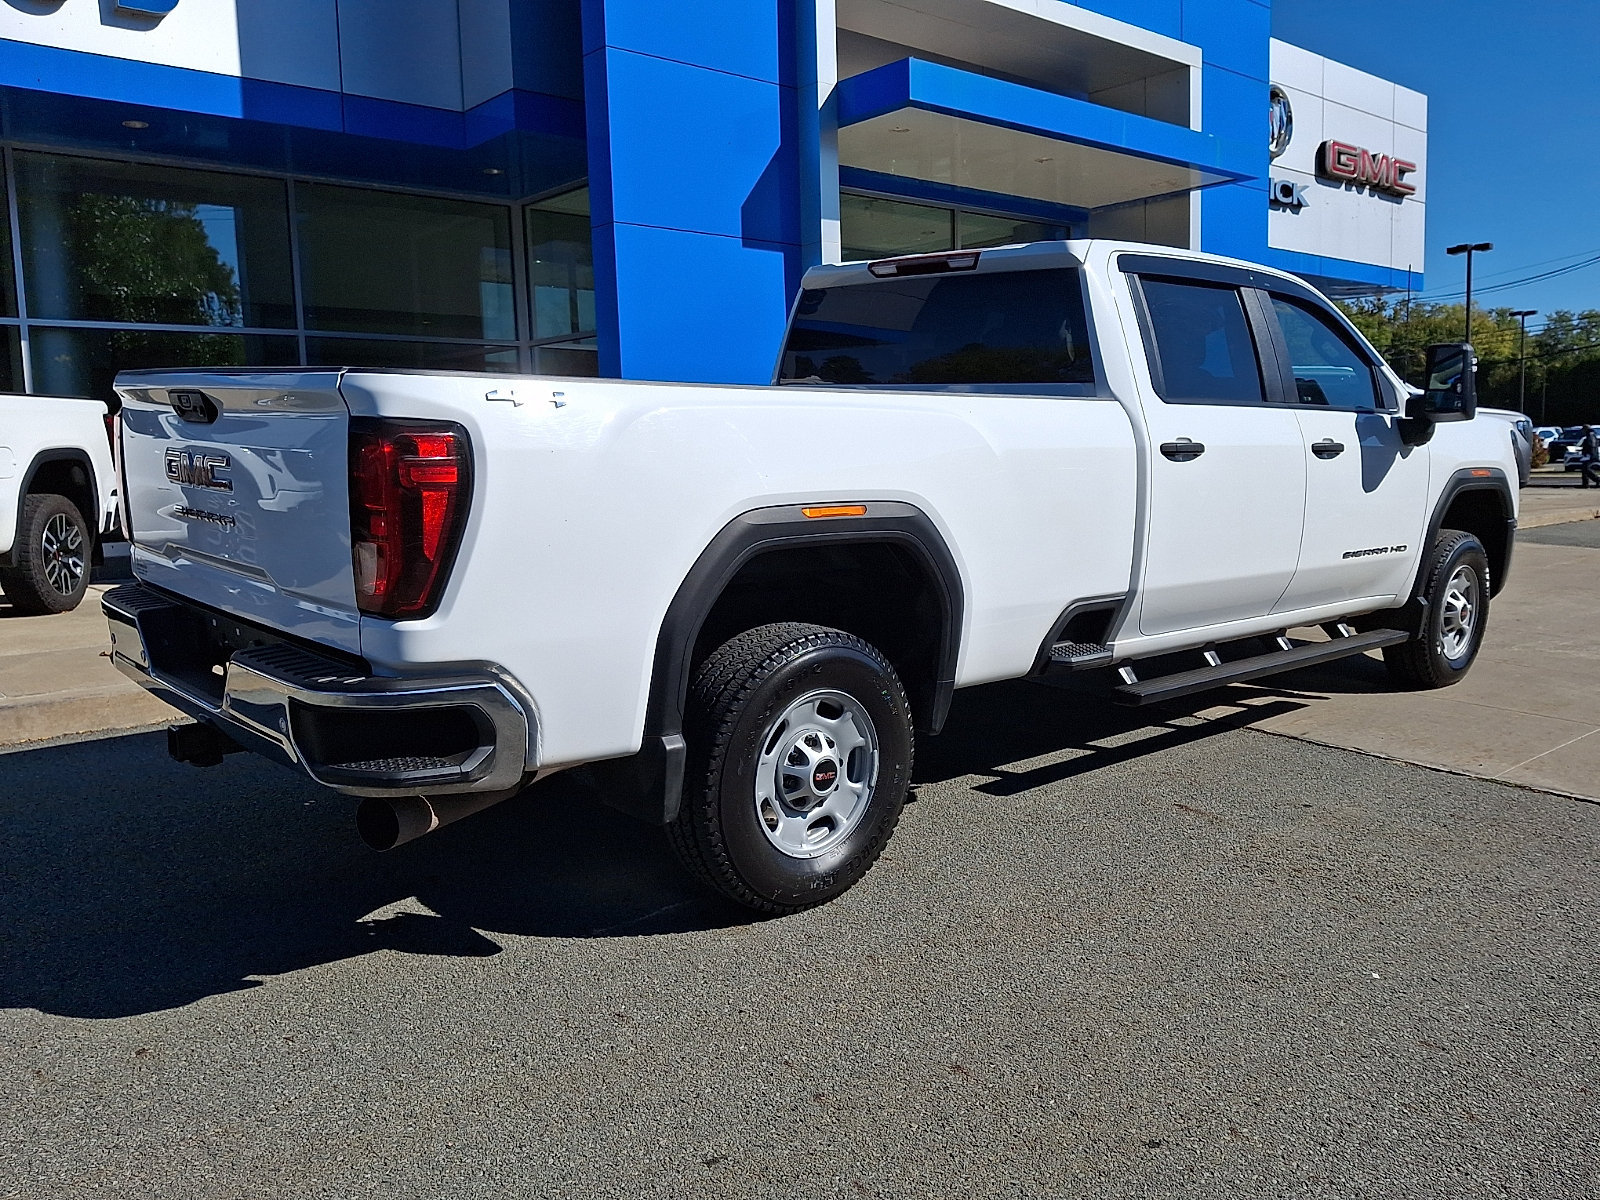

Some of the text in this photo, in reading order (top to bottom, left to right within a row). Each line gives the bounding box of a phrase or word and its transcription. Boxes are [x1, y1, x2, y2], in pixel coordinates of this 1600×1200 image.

[1326, 140, 1416, 195] GMC
[165, 447, 233, 492] GMC
[1342, 544, 1408, 560] SIERRA HD
[815, 771, 836, 781] GMC
